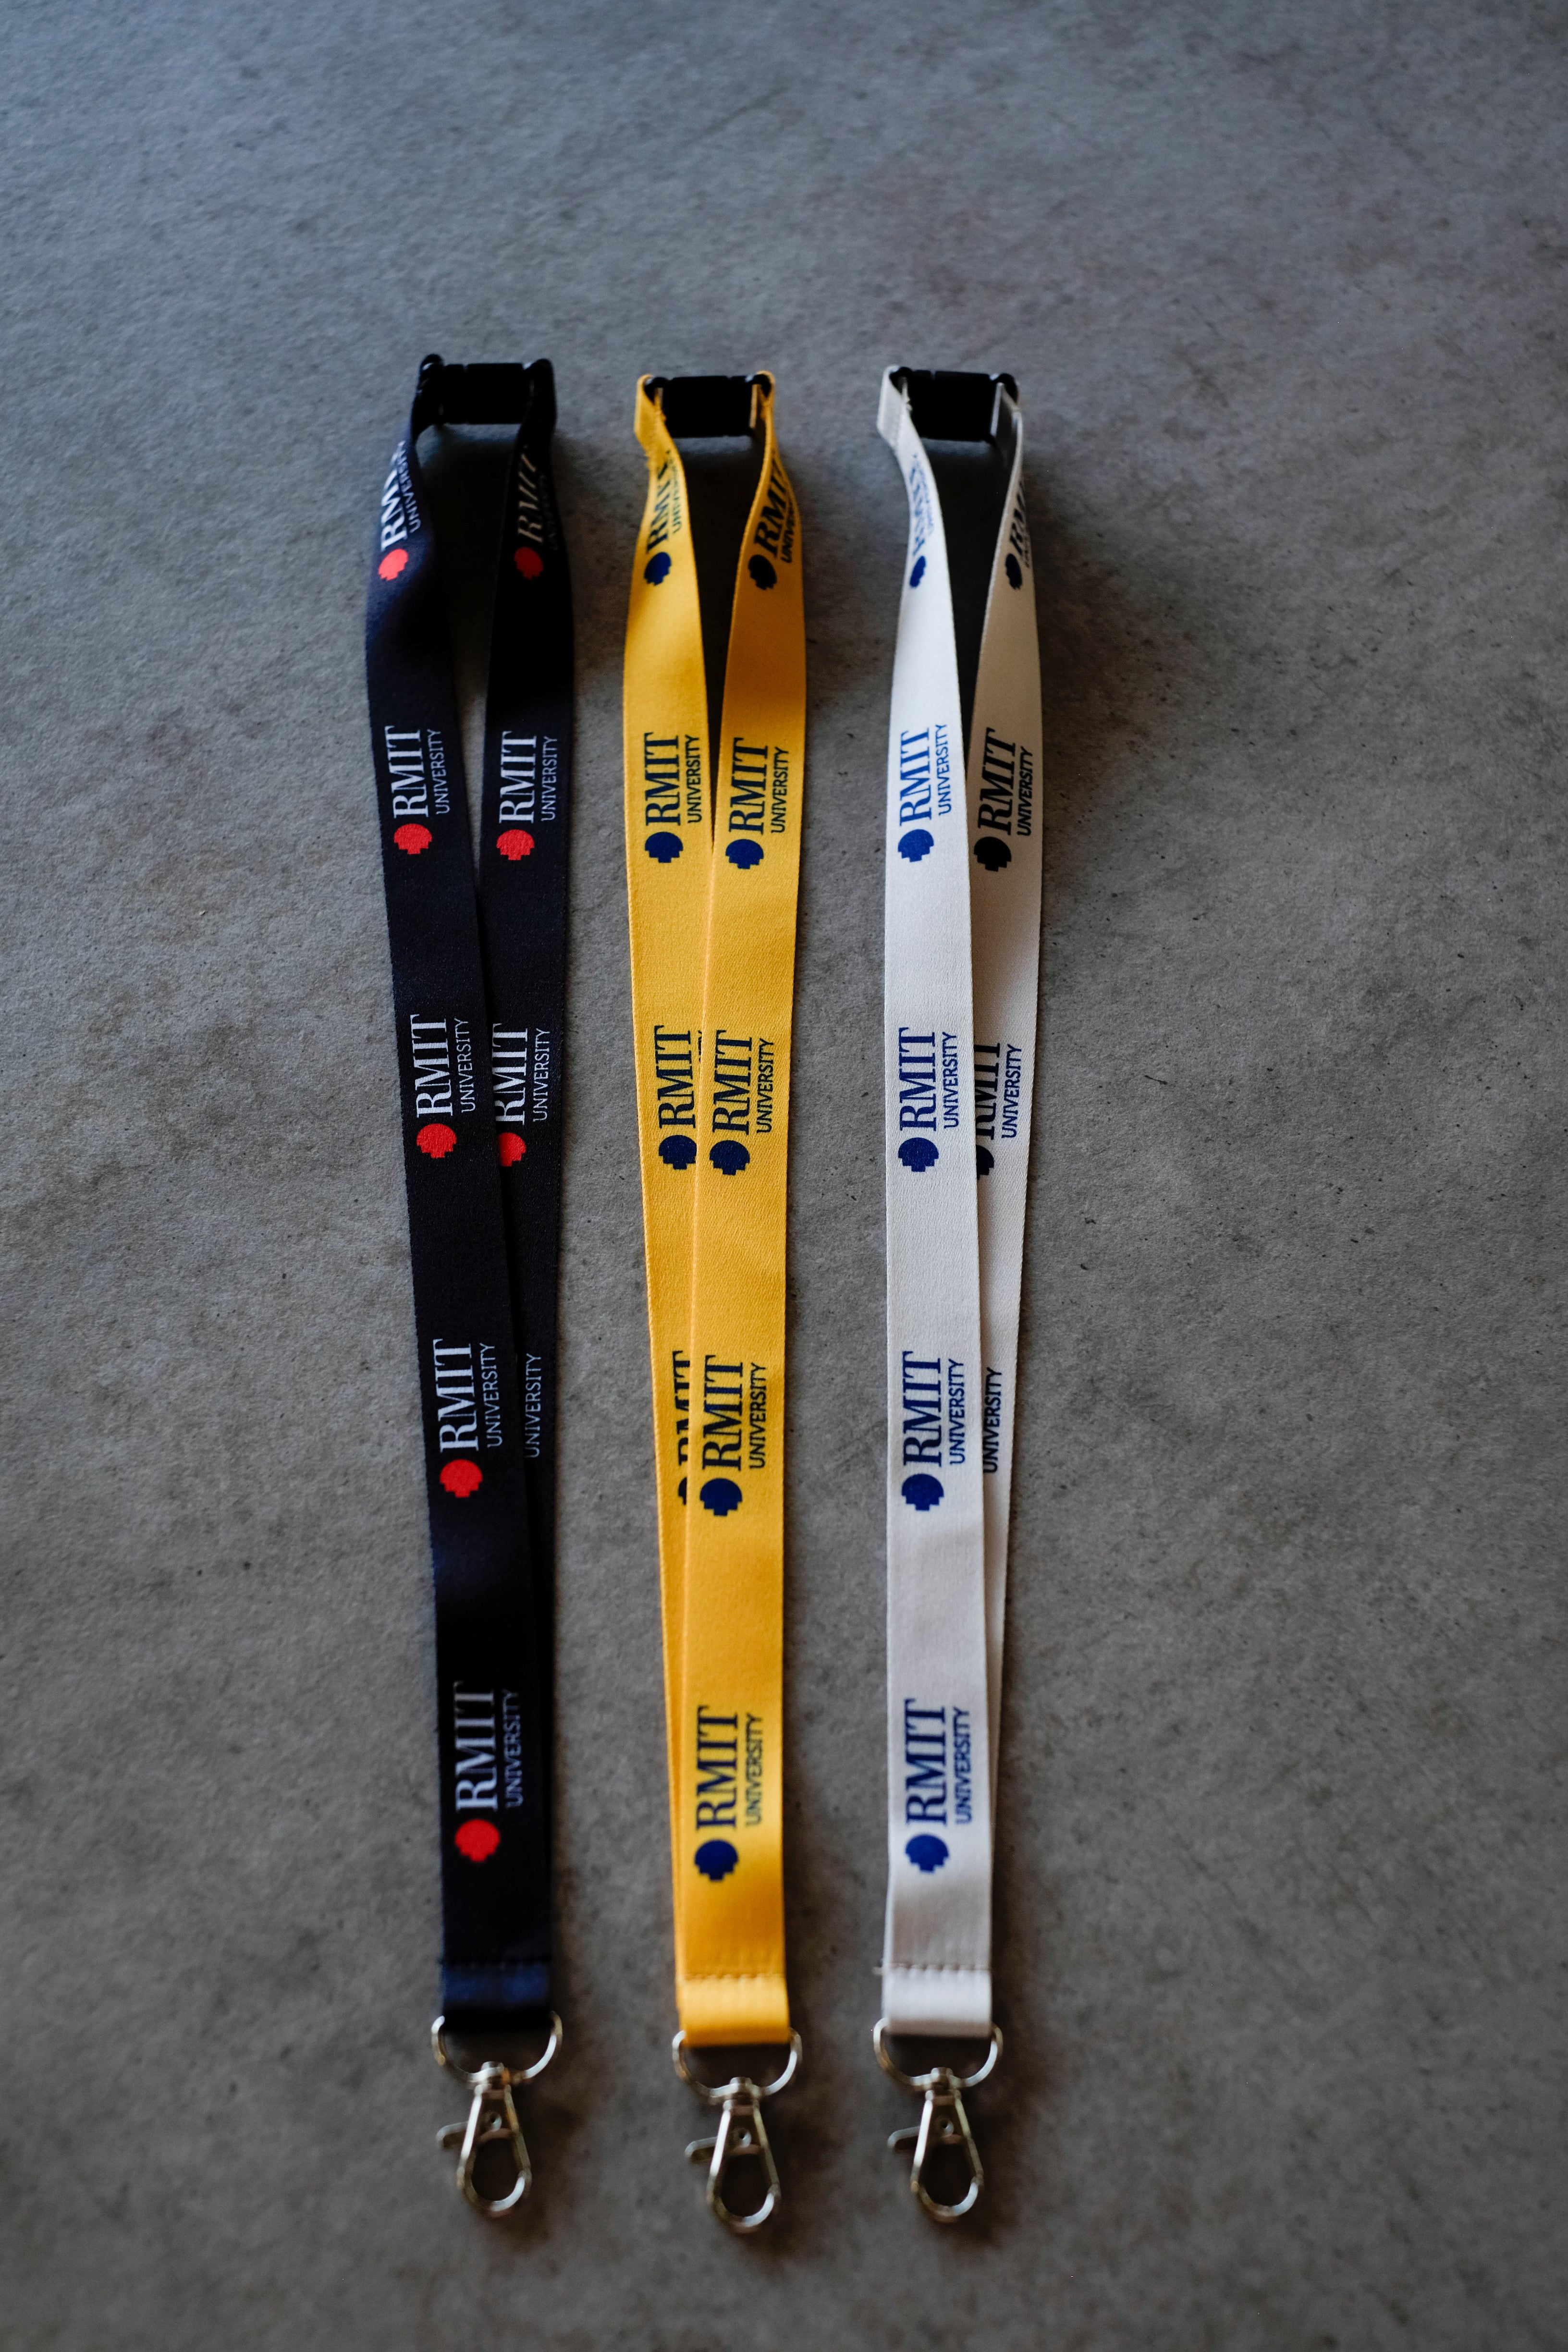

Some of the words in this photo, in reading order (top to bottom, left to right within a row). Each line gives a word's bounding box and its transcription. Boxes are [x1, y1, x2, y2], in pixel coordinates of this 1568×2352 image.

[385, 726, 429, 818] RMIT
[427, 729, 450, 815] UNIVERSITY
[499, 731, 537, 823] RMIT
[541, 735, 557, 821] UNIVERSITY
[644, 732, 680, 826] RMIT
[685, 735, 702, 823] UNIVERSITY
[728, 737, 768, 835] RMIT
[771, 747, 789, 833] UNIVERSITY
[900, 728, 931, 826] RMIT
[935, 724, 952, 816] UNIVERSITY
[978, 727, 1016, 835] RMIT
[1017, 747, 1033, 836] UNIVERSITY
[410, 1014, 453, 1118] RMIT
[454, 1018, 476, 1113] UNIVERSITY
[492, 1023, 527, 1125] RMIT
[533, 1028, 550, 1122] UNIVERSITY
[654, 1025, 696, 1129] RMIT
[712, 1029, 752, 1135] RMIT
[757, 1038, 773, 1134] UNIVERSITY
[898, 1027, 936, 1131] RMIT
[942, 1031, 959, 1129] UNIVERSITY
[1002, 1043, 1022, 1139] UNIVERSITY
[433, 1339, 478, 1453] RMIT
[480, 1343, 502, 1448] UNIVERSITY
[525, 1353, 541, 1459] UNIVERSITY
[702, 1355, 743, 1471] RMIT
[749, 1362, 766, 1470] UNIVERSITY
[902, 1350, 942, 1468] RMIT
[948, 1359, 964, 1465] UNIVERSITY
[983, 1366, 1002, 1474] UNIVERSITY
[453, 1681, 498, 1812] RMIT
[502, 1689, 524, 1808] UNIVERSITY
[696, 1704, 738, 1832] RMIT
[745, 1712, 762, 1827] UNIVERSITY
[904, 1698, 947, 1827] RMIT
[953, 1706, 971, 1824] UNIVERSITY
